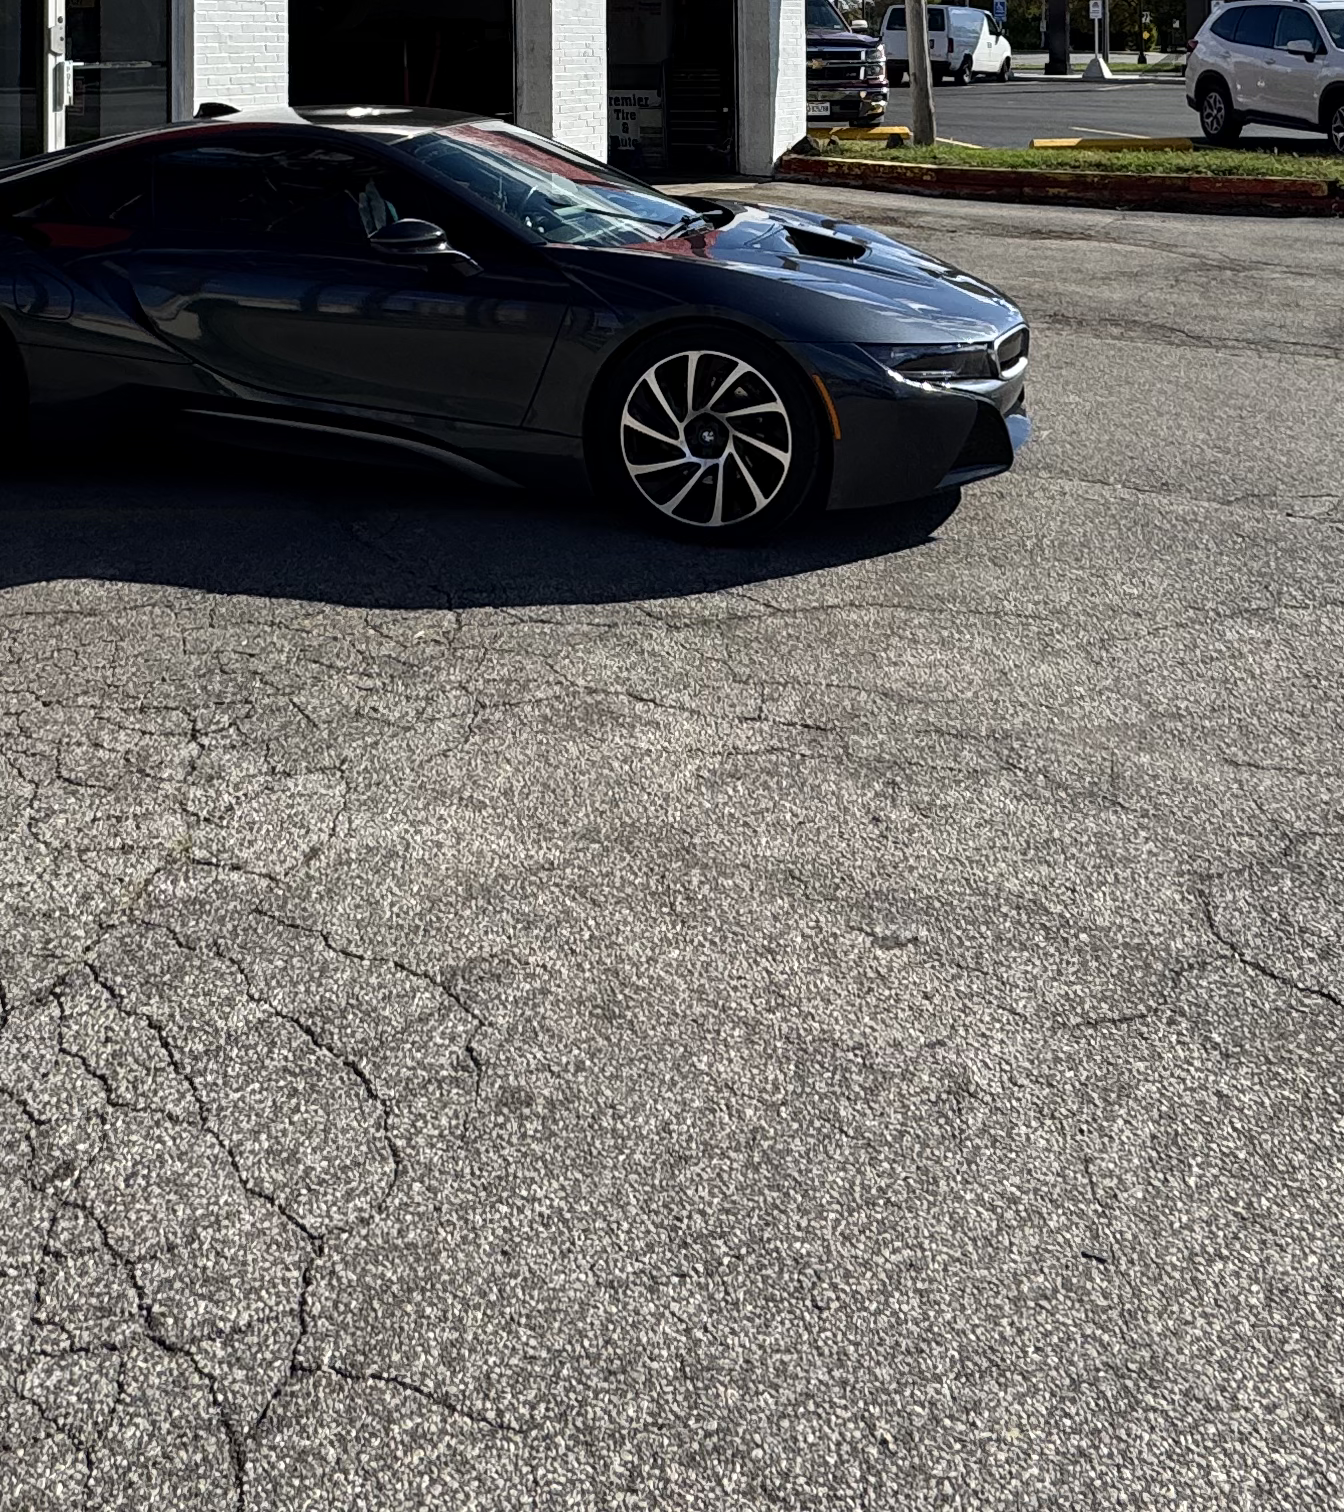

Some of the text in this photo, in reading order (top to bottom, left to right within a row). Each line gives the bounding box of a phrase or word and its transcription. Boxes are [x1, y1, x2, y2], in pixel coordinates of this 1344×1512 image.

[608, 93, 650, 107] remier
[613, 108, 637, 121] Tire
[621, 121, 629, 134] &
